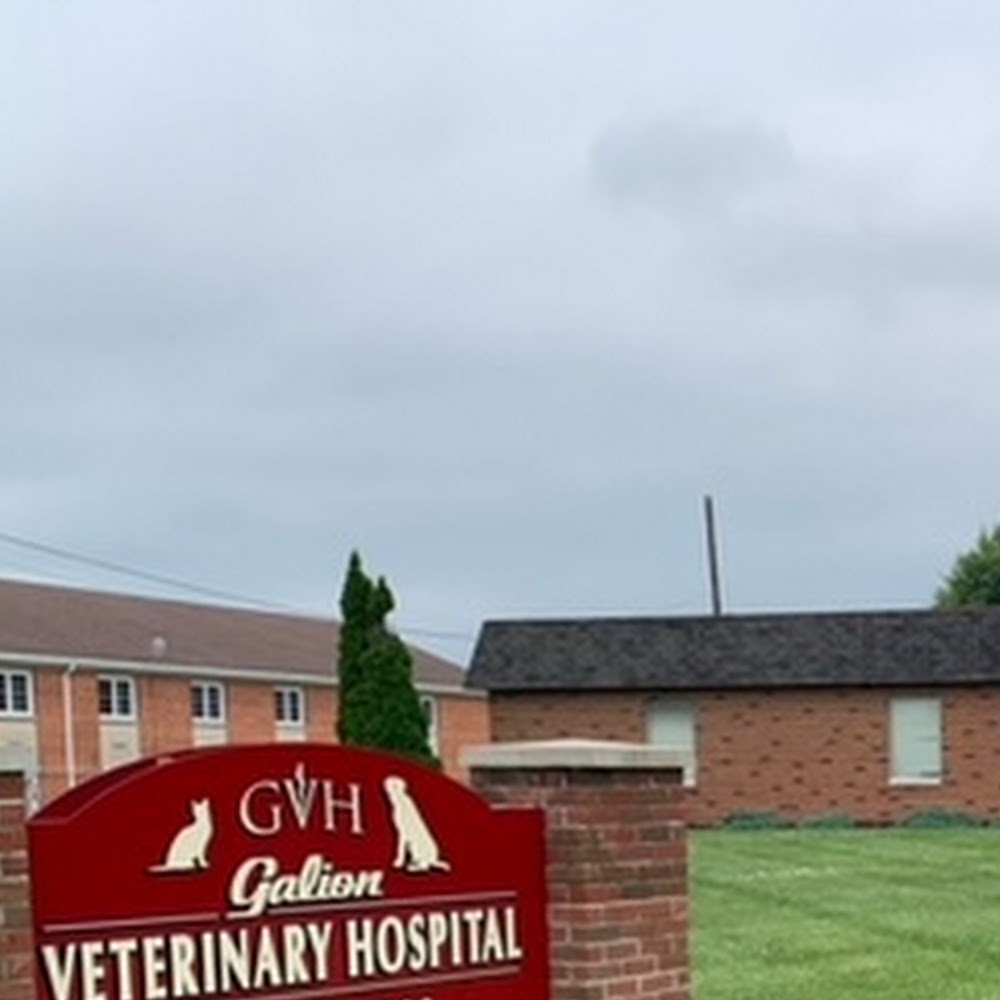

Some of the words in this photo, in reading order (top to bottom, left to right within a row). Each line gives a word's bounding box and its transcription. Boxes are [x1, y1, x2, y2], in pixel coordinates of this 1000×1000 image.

[239, 776, 364, 836] GVH
[227, 854, 384, 918] Galion
[347, 907, 523, 977] HOSPITAL
